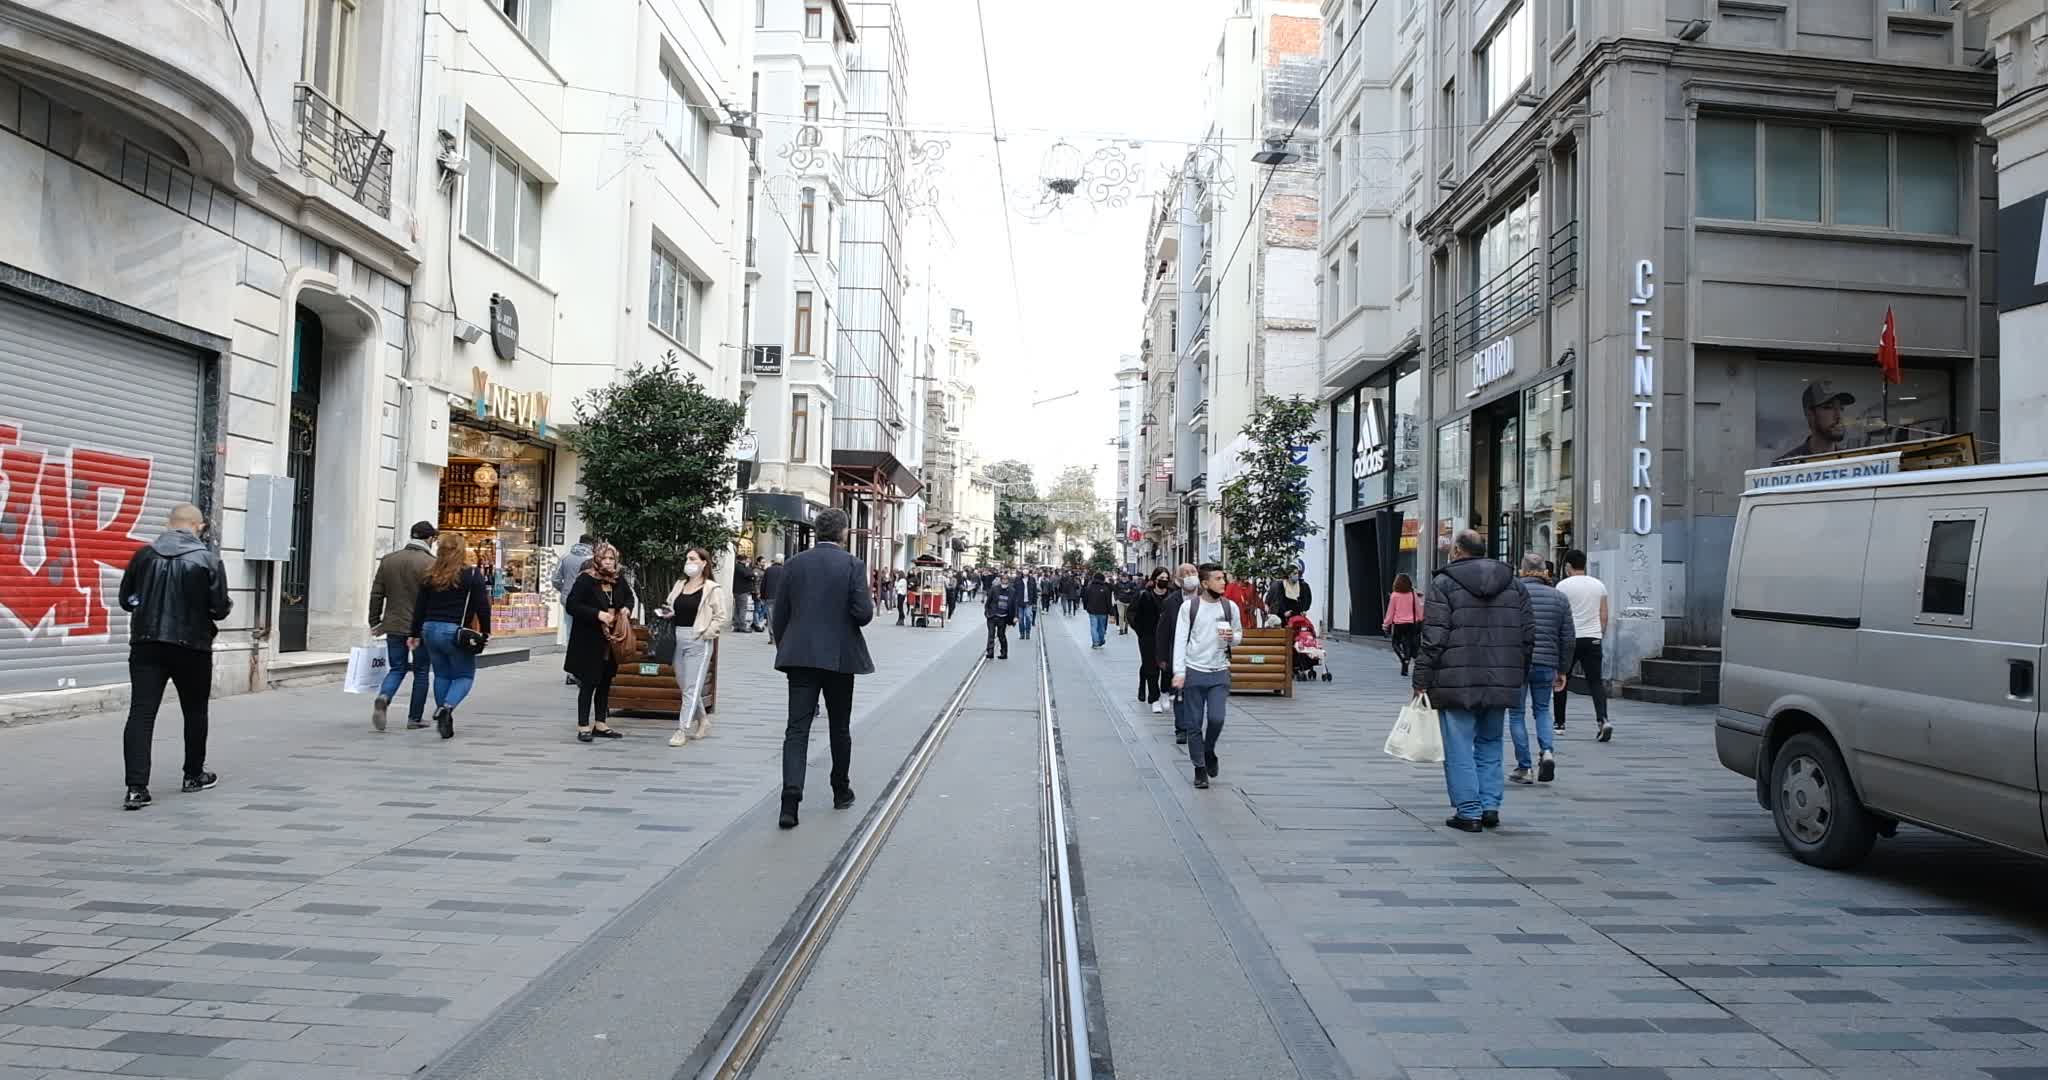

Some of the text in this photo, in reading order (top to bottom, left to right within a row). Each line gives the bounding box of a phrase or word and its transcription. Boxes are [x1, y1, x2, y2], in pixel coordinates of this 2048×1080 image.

[761, 347, 774, 364] L
[1472, 335, 1512, 391] CENTRO
[1632, 259, 1654, 535] CENTRO
[1354, 446, 1384, 479] adidas
